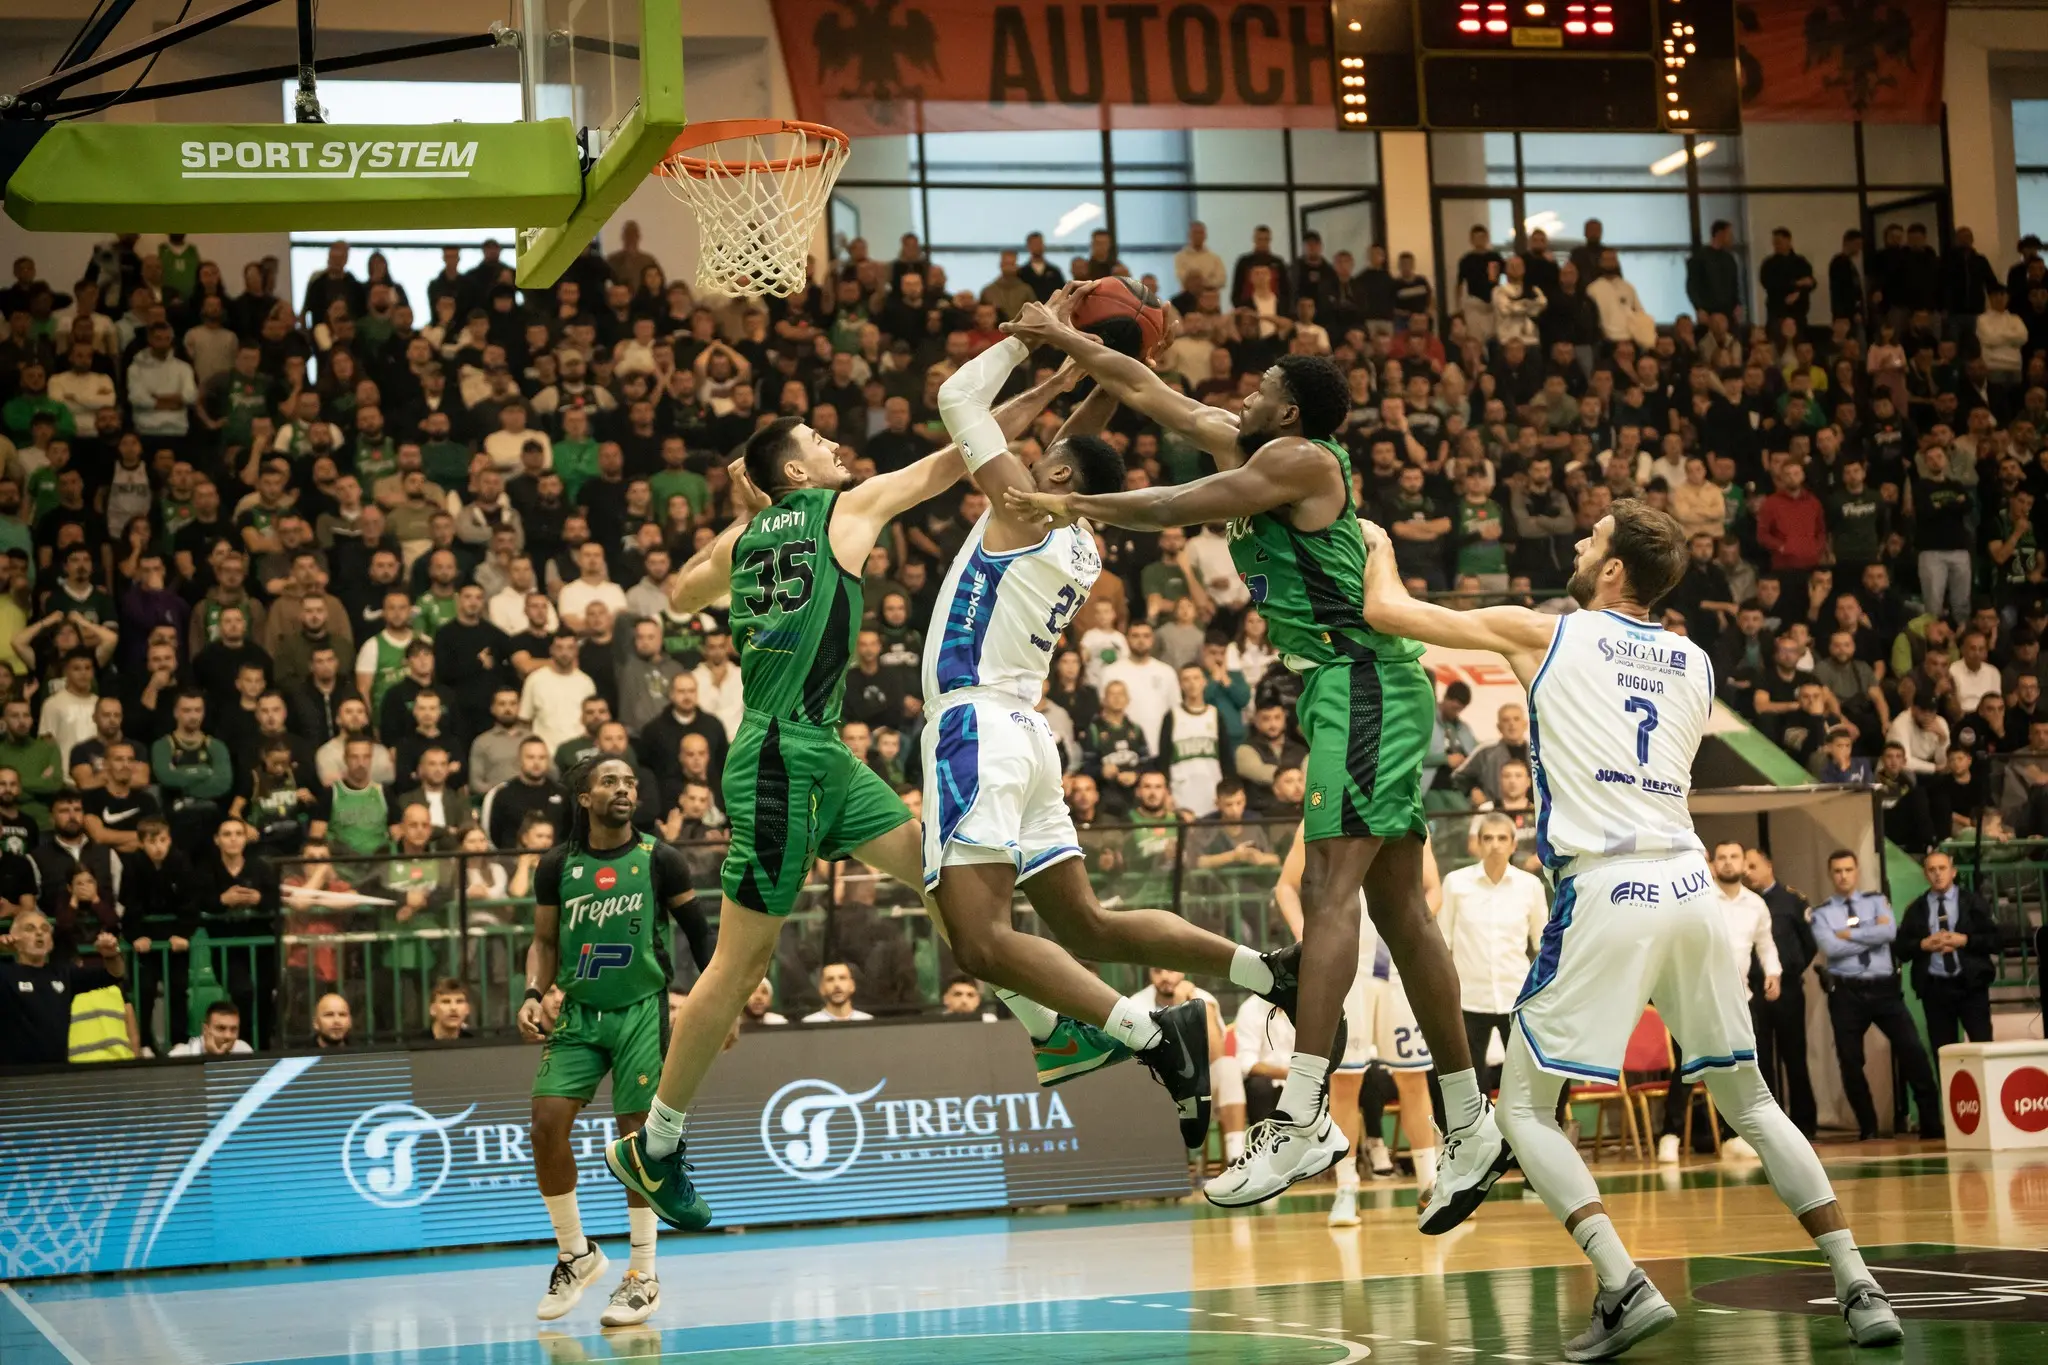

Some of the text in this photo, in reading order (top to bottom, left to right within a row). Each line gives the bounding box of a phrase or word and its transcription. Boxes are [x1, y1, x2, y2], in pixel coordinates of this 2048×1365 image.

[181, 141, 479, 178] SPORT SYSTEM
[761, 511, 806, 533] KAPITI
[742, 537, 817, 617] 35
[963, 570, 987, 631] MOKNE
[1614, 659, 1686, 677] UNIQA GROUP AUSTRIA
[1616, 640, 1669, 664] SIGAL
[1617, 673, 1664, 694] RUGOVA
[1624, 695, 1658, 767] 7
[1671, 869, 1710, 900] LUX
[565, 893, 643, 931] Trepca
[629, 918, 642, 935] 5
[875, 1090, 1075, 1140] TREGTIA
